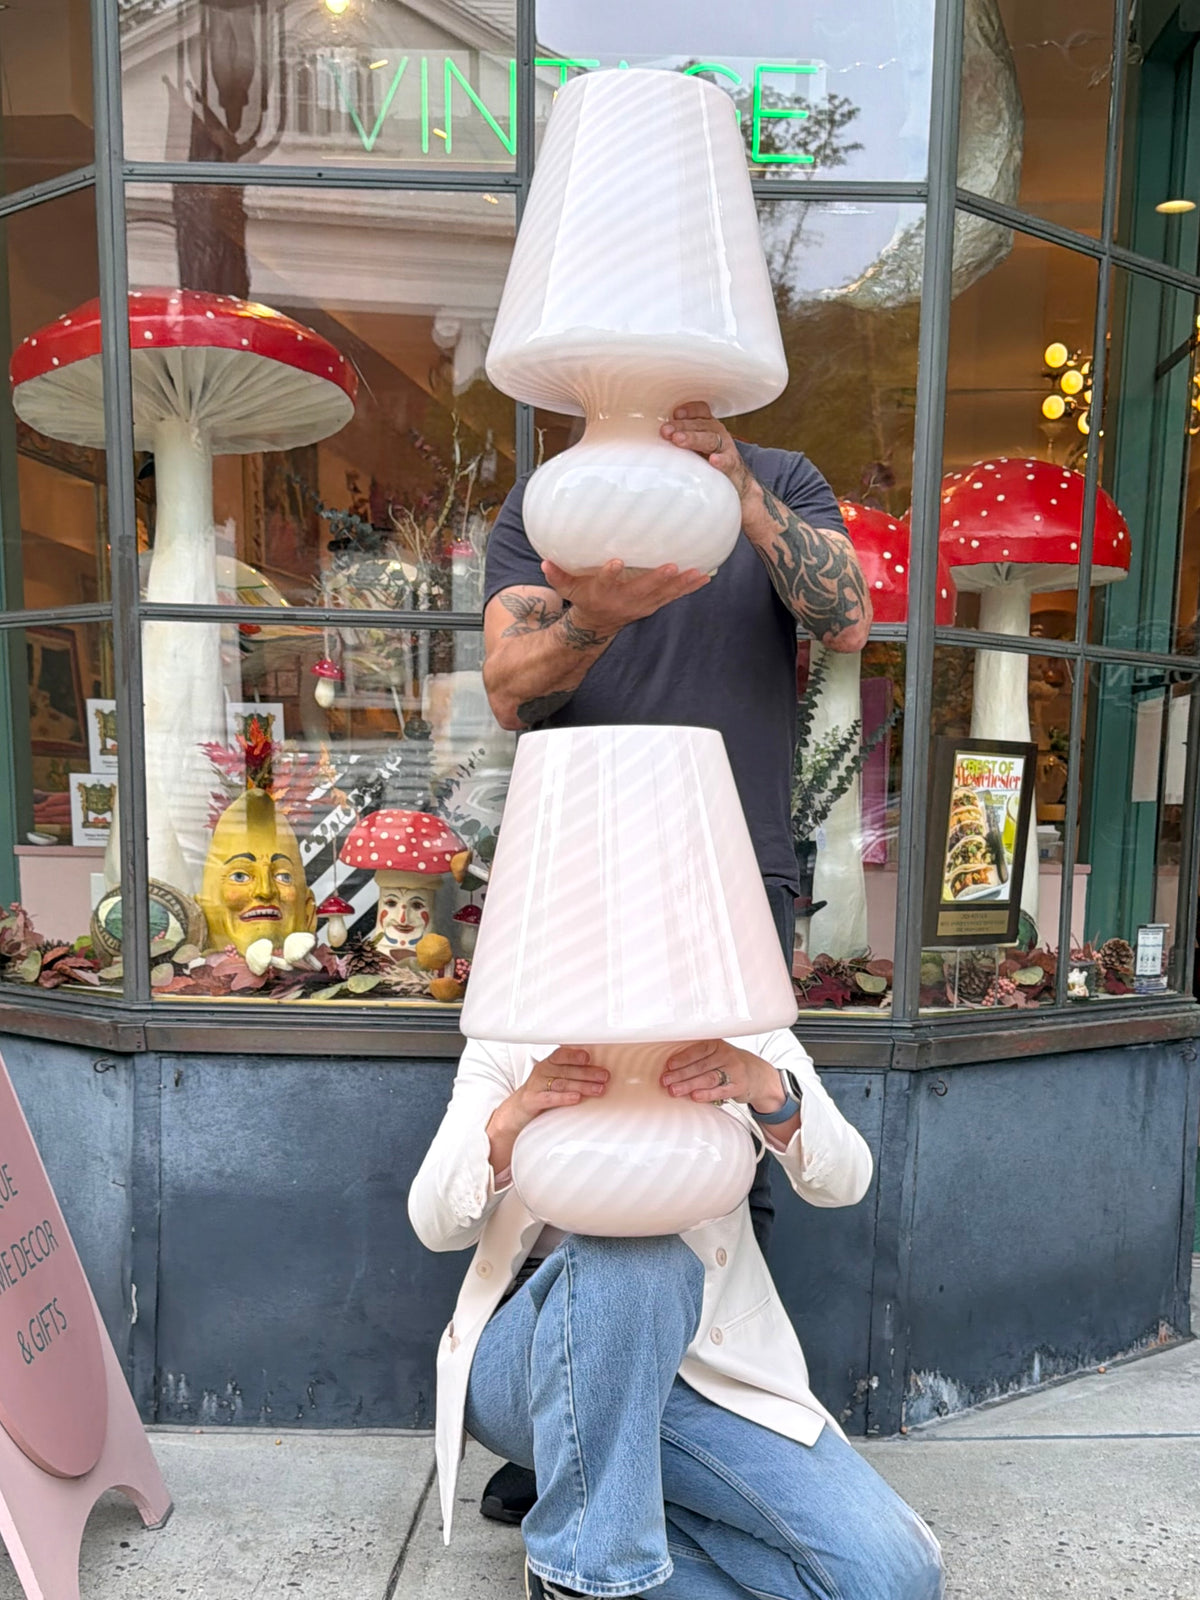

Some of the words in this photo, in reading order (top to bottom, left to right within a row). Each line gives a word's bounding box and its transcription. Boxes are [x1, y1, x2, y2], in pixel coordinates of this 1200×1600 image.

[333, 56, 819, 163] VINTE
[967, 759, 998, 776] BEST
[999, 761, 1015, 775] OF
[0, 1164, 18, 1208] UE
[10, 1219, 59, 1278] DECOR
[17, 1330, 35, 1365] &
[29, 1297, 67, 1352] GIFTS
